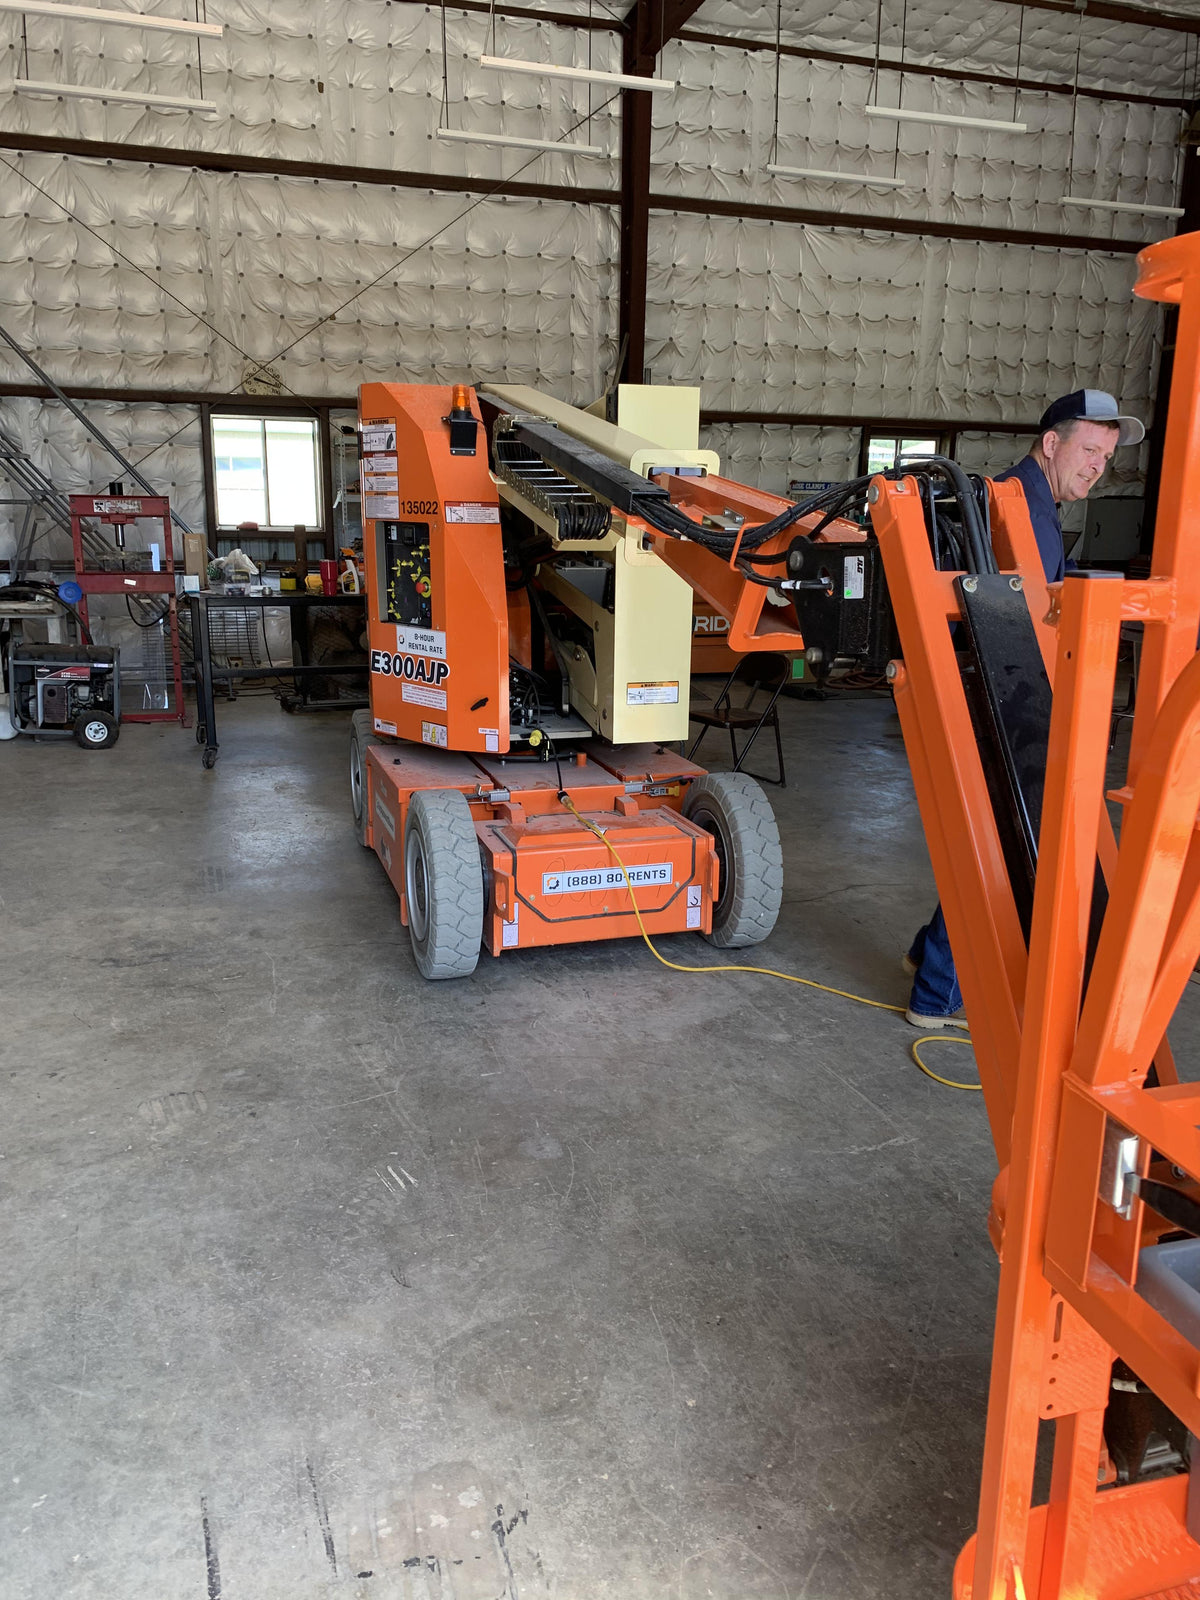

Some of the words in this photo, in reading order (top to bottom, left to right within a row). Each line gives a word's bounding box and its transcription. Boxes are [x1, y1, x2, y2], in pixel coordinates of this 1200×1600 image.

[401, 500, 438, 515] 135022
[694, 615, 731, 632] RID
[408, 642, 428, 652] RENTAL
[429, 645, 443, 655] RATE
[371, 650, 449, 685] E300AJP
[567, 874, 602, 888] (888)
